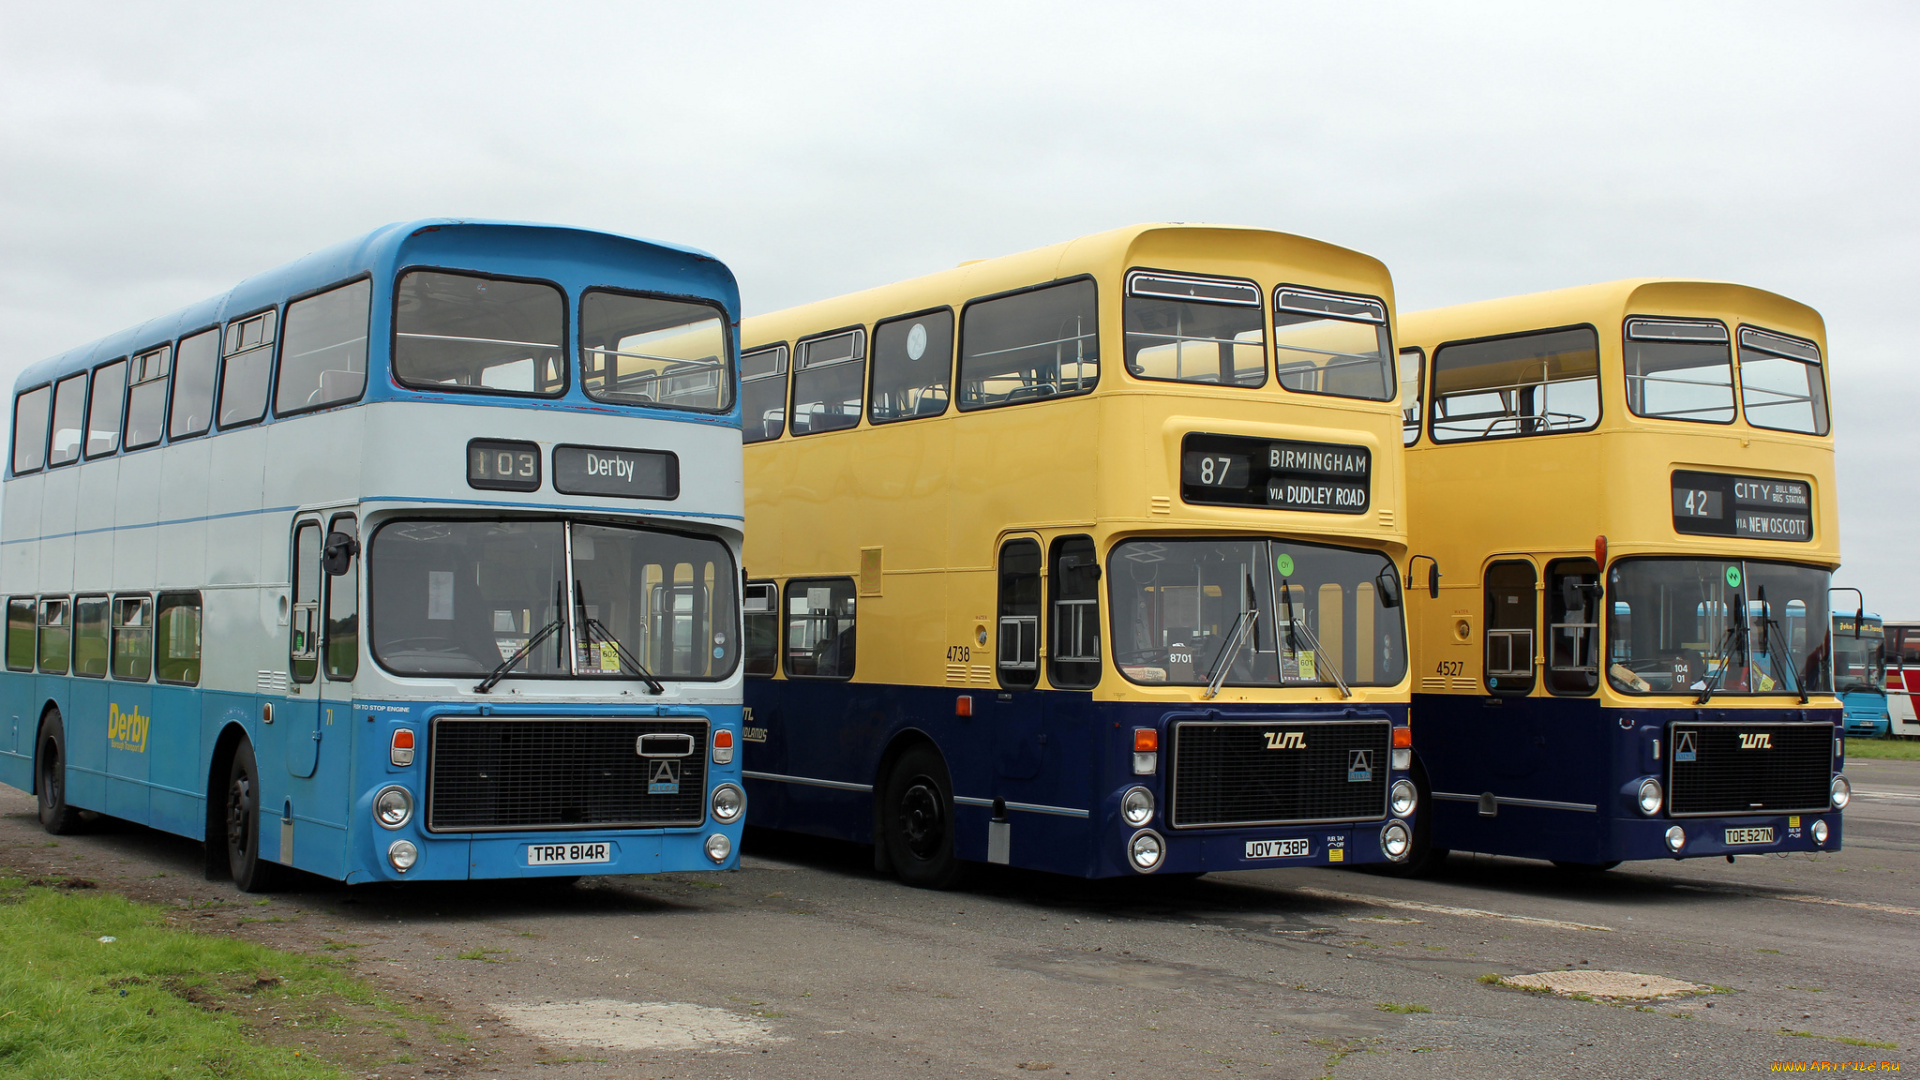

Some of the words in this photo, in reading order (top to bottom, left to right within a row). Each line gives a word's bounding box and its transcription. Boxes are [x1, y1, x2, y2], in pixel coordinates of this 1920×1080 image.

[478, 451, 535, 477] 103
[587, 453, 635, 483] Derby
[1270, 449, 1366, 473] BIRMINGHAM
[1201, 457, 1232, 485] 87
[1270, 488, 1284, 501] VIA
[1287, 485, 1333, 505] DUDLEY
[1335, 487, 1366, 506] ROAD
[1734, 482, 1771, 500] CITY
[1772, 493, 1783, 503] BUS
[1785, 494, 1806, 504] STATION
[1775, 485, 1788, 494] BULL
[1789, 485, 1802, 495] RING
[1685, 490, 1708, 516] 42
[1735, 518, 1747, 529] VIA
[1749, 516, 1769, 533] NEW
[1770, 518, 1806, 535] OSCOTT
[946, 645, 970, 662] 4738
[1169, 653, 1192, 663] 8701
[1436, 661, 1464, 676] 4527
[1674, 664, 1688, 673] 104
[1676, 674, 1685, 683] 01
[326, 708, 333, 726] 71
[108, 702, 150, 753] Derby
[1726, 830, 1746, 843] TOE
[1747, 829, 1773, 842] 527N
[534, 846, 566, 862] TRR
[570, 844, 605, 860] 814R
[1247, 842, 1272, 857] JOV
[1275, 840, 1308, 856] 738P
